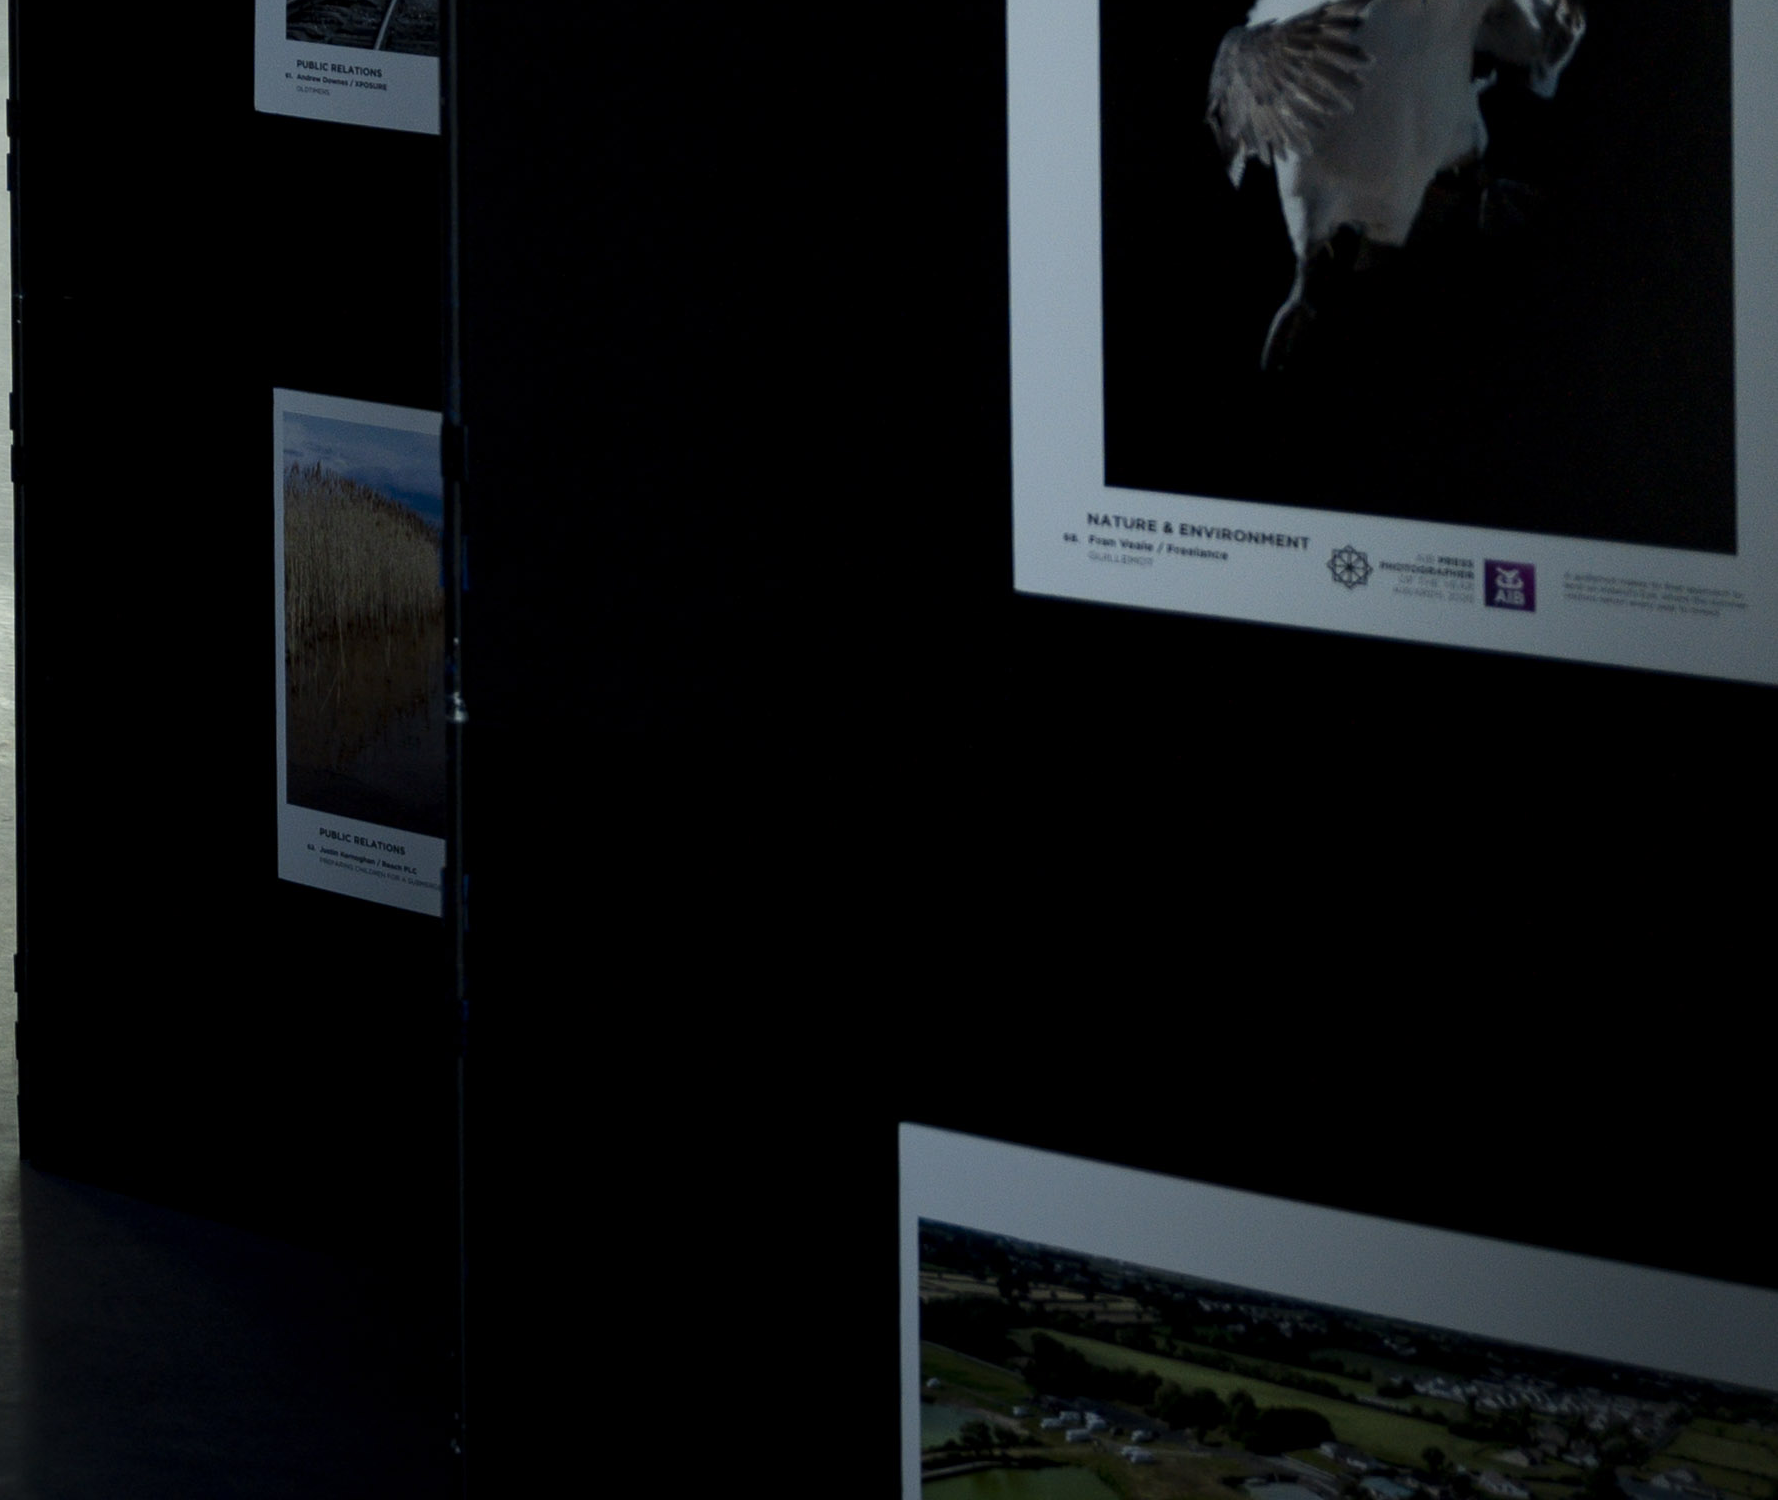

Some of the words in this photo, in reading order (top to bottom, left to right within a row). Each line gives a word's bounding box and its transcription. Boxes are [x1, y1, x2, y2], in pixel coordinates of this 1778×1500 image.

[296, 59, 329, 72] PUBLIC
[330, 63, 383, 78] RELATIONS
[297, 73, 321, 83] Andrew
[354, 80, 387, 91] XPOSURE
[1086, 512, 1157, 533] NATURE
[1163, 521, 1174, 534] &
[1179, 522, 1310, 550] ENVIRONMENT
[1493, 589, 1525, 606] AIB
[319, 827, 351, 843] PUBLIC
[353, 835, 406, 856] RELATIONS
